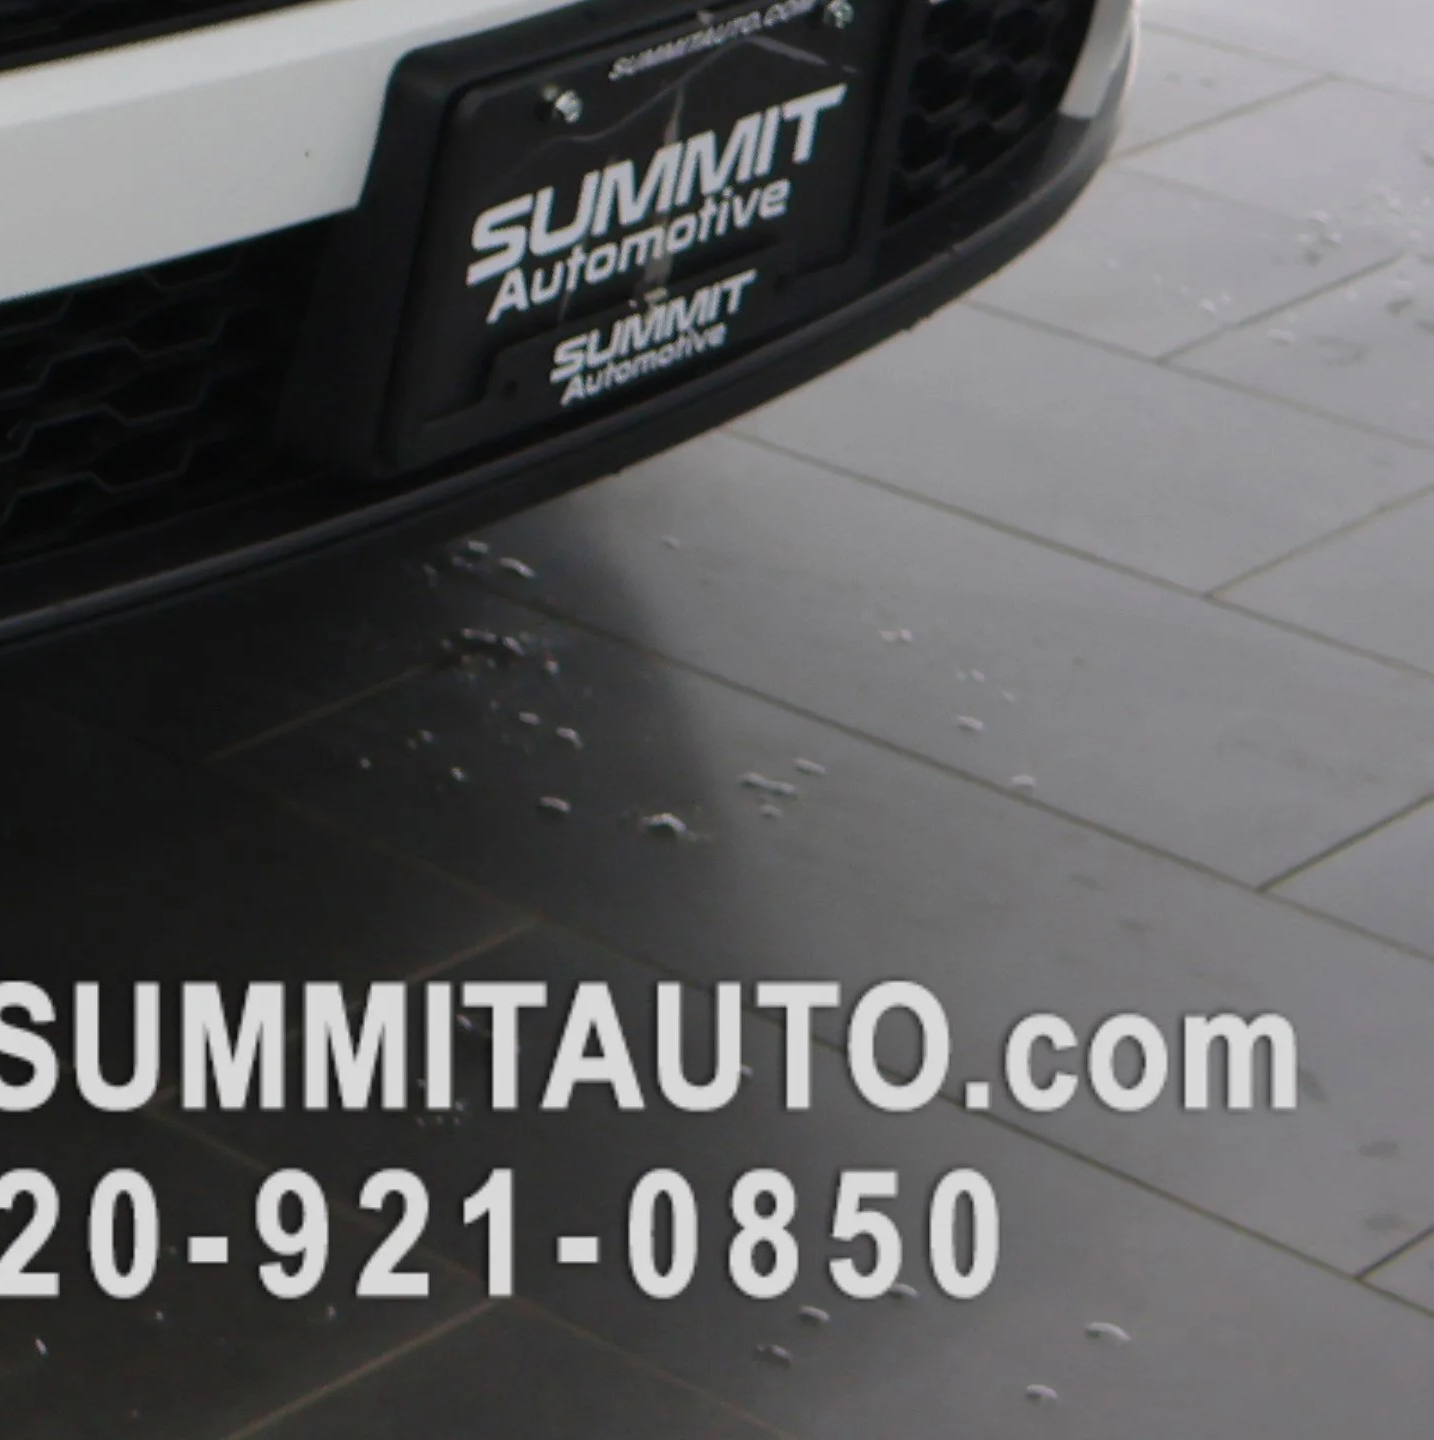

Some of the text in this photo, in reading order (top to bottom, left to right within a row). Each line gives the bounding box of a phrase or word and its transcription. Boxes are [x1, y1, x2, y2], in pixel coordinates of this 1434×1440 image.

[466, 83, 848, 286] SUMMIT
[486, 177, 791, 325] Automotive
[550, 270, 758, 384] SUMMIT
[560, 322, 727, 407] Automotive
